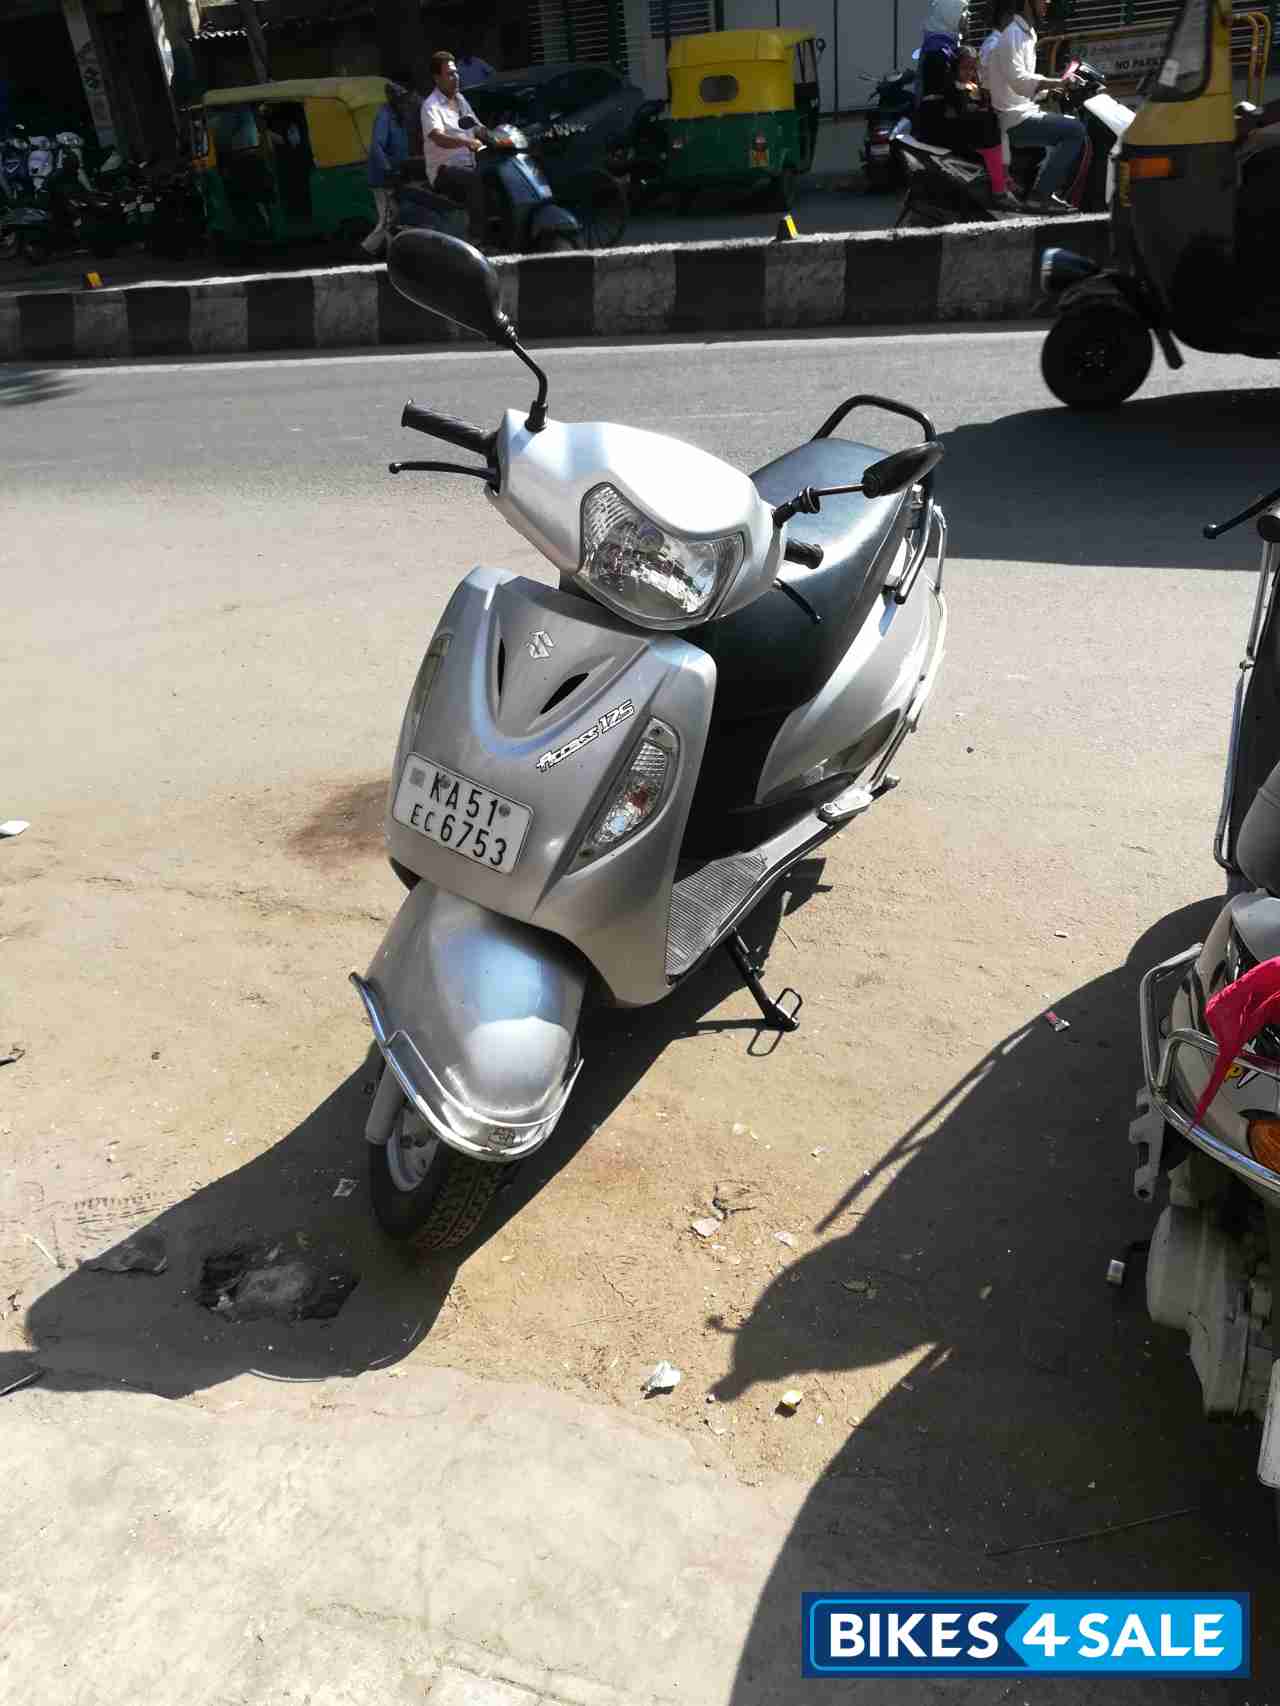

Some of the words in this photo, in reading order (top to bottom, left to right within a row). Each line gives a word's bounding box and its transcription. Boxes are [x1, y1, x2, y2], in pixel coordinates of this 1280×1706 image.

[536, 724, 600, 772] Access
[599, 699, 634, 735] 125
[429, 771, 460, 811] KA
[465, 788, 499, 827] 51
[410, 803, 435, 832] EC
[440, 814, 508, 866] 6753
